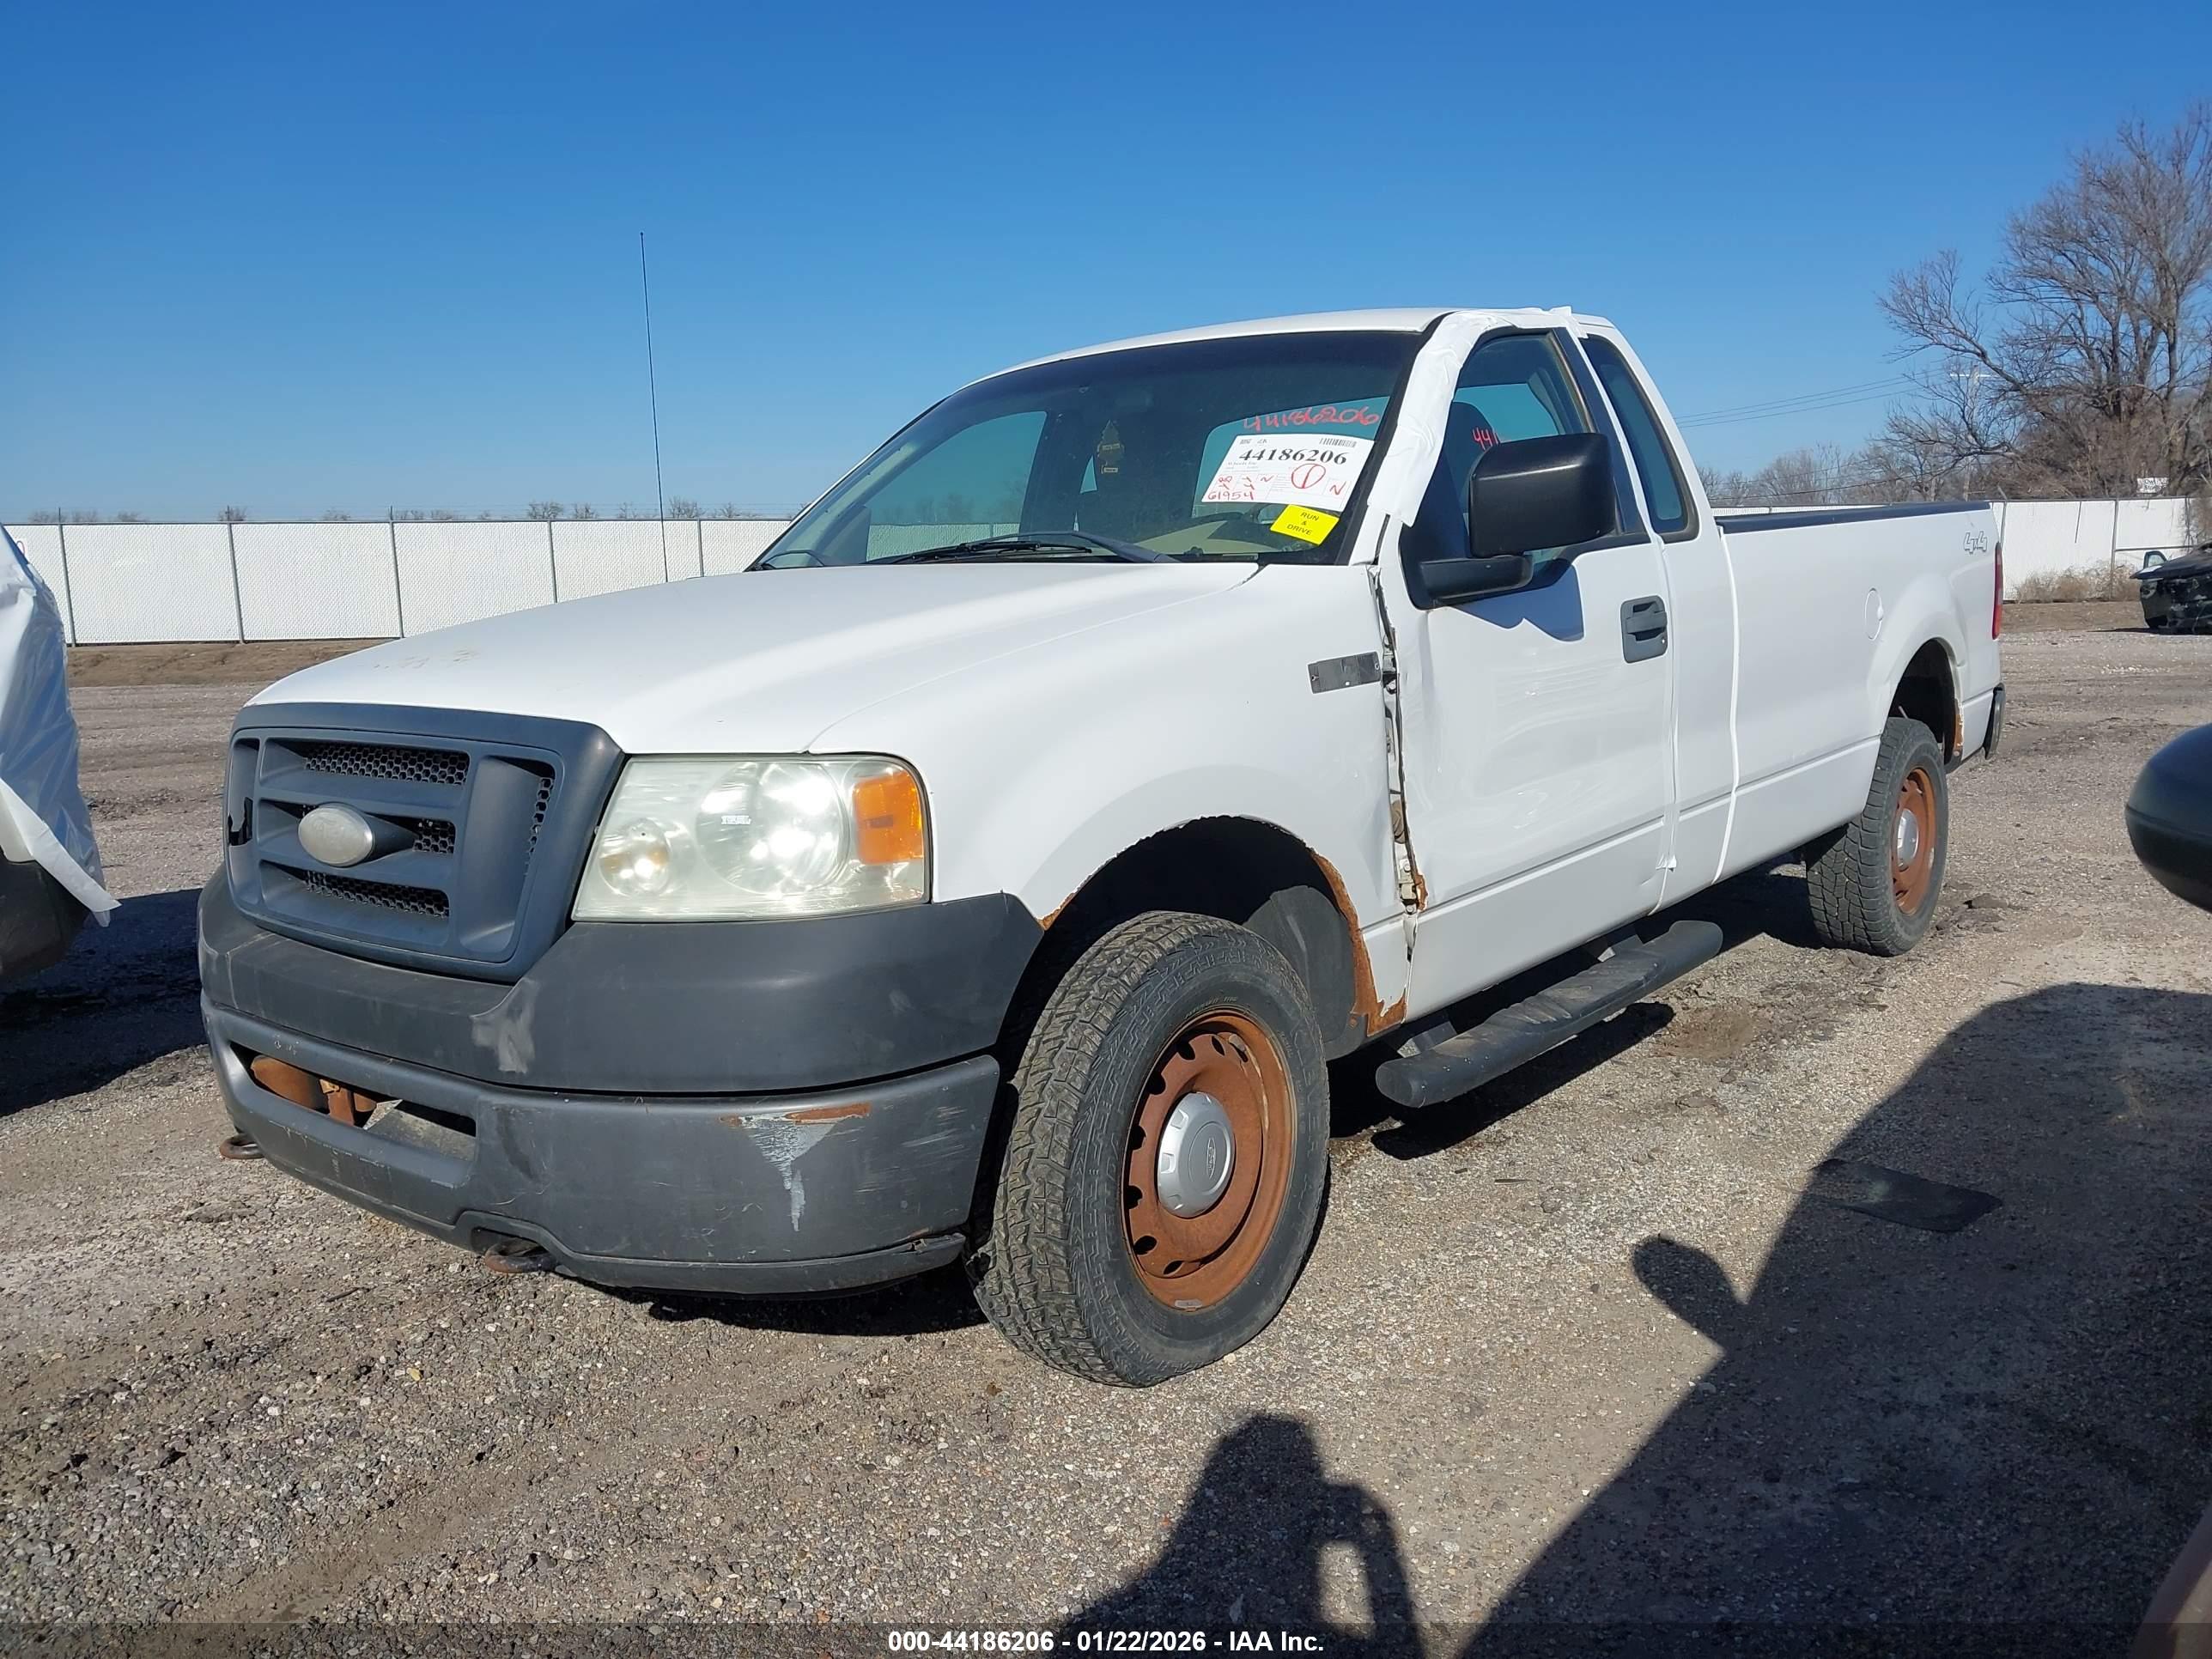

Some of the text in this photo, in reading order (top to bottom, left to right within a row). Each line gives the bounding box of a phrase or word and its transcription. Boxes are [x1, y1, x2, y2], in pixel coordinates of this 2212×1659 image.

[1239, 447, 1351, 465] 44186206
[1300, 512, 1320, 522] RUN
[1286, 524, 1313, 536] DRIVE
